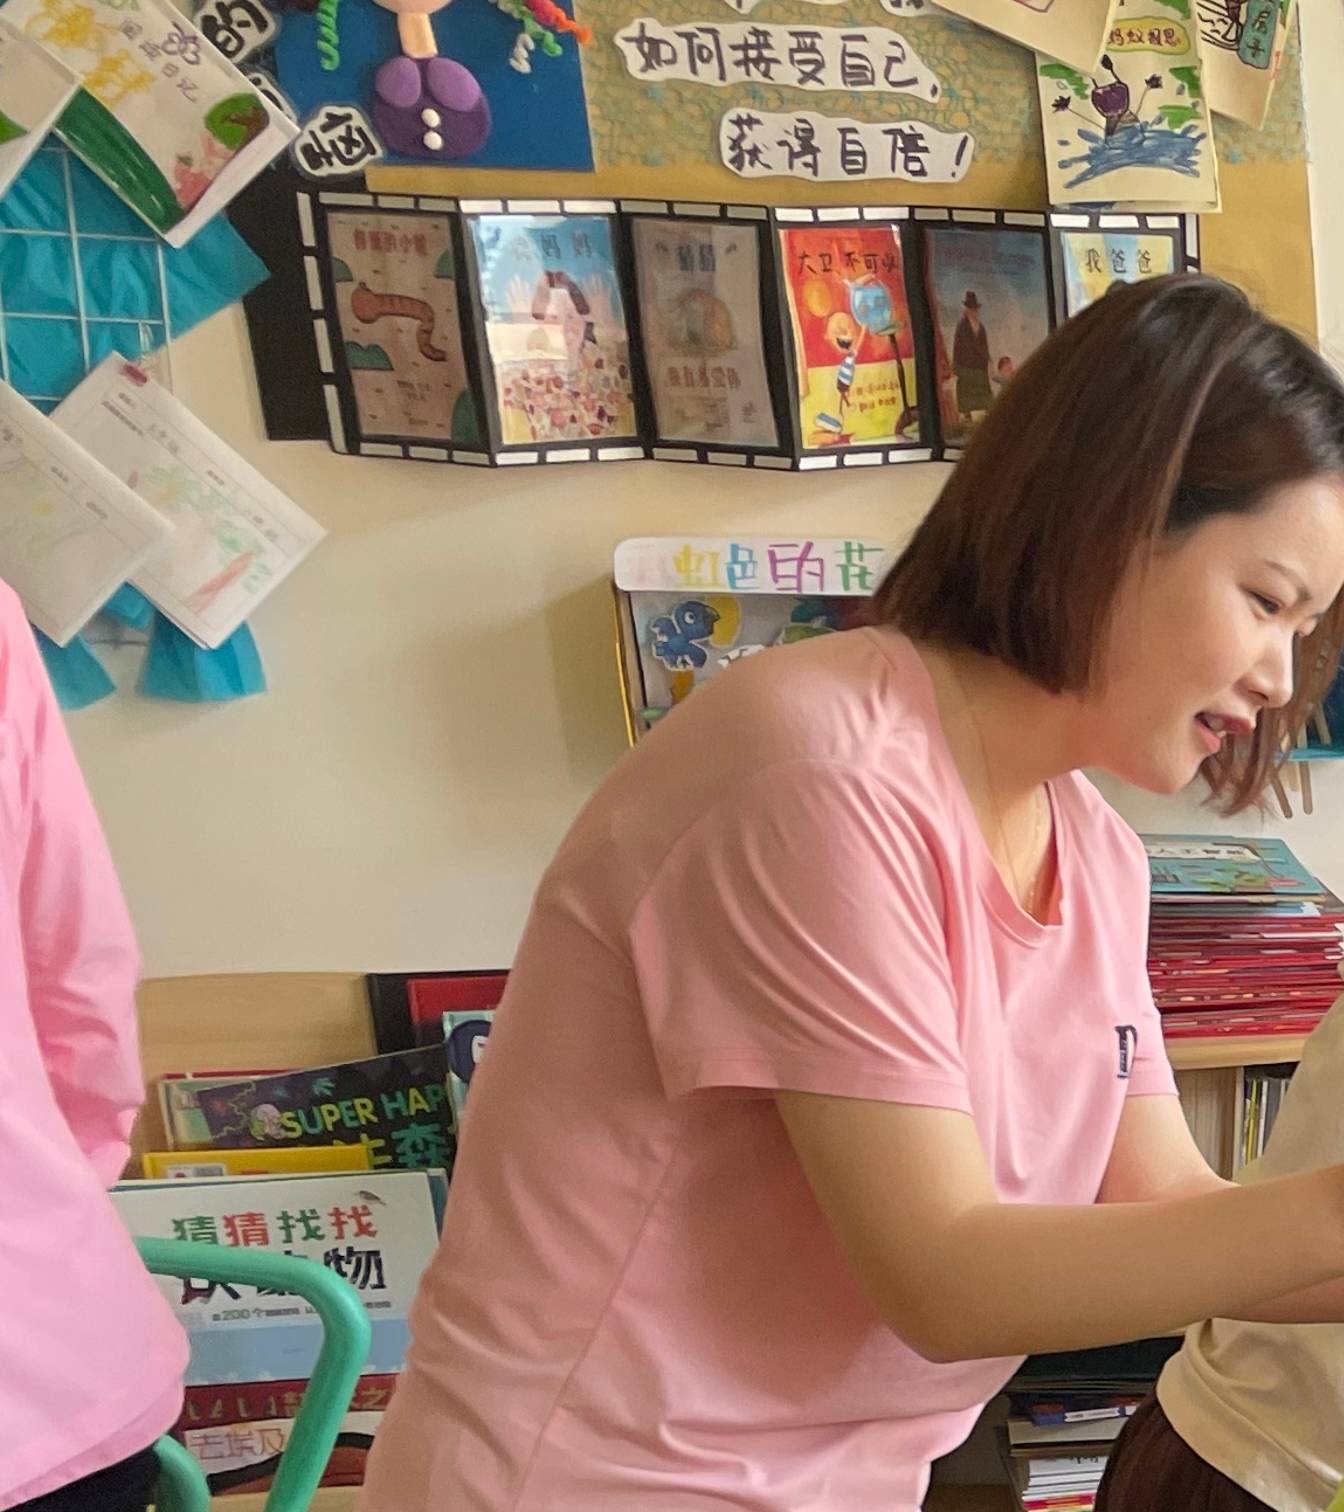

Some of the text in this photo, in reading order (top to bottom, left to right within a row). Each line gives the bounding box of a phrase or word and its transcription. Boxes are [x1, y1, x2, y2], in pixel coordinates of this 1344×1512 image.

[1085, 247, 1153, 275] 我爸爸
[632, 540, 885, 592] 虹色的花
[280, 1096, 378, 1140] SUPER
[172, 1204, 377, 1247] 猜猜找找
